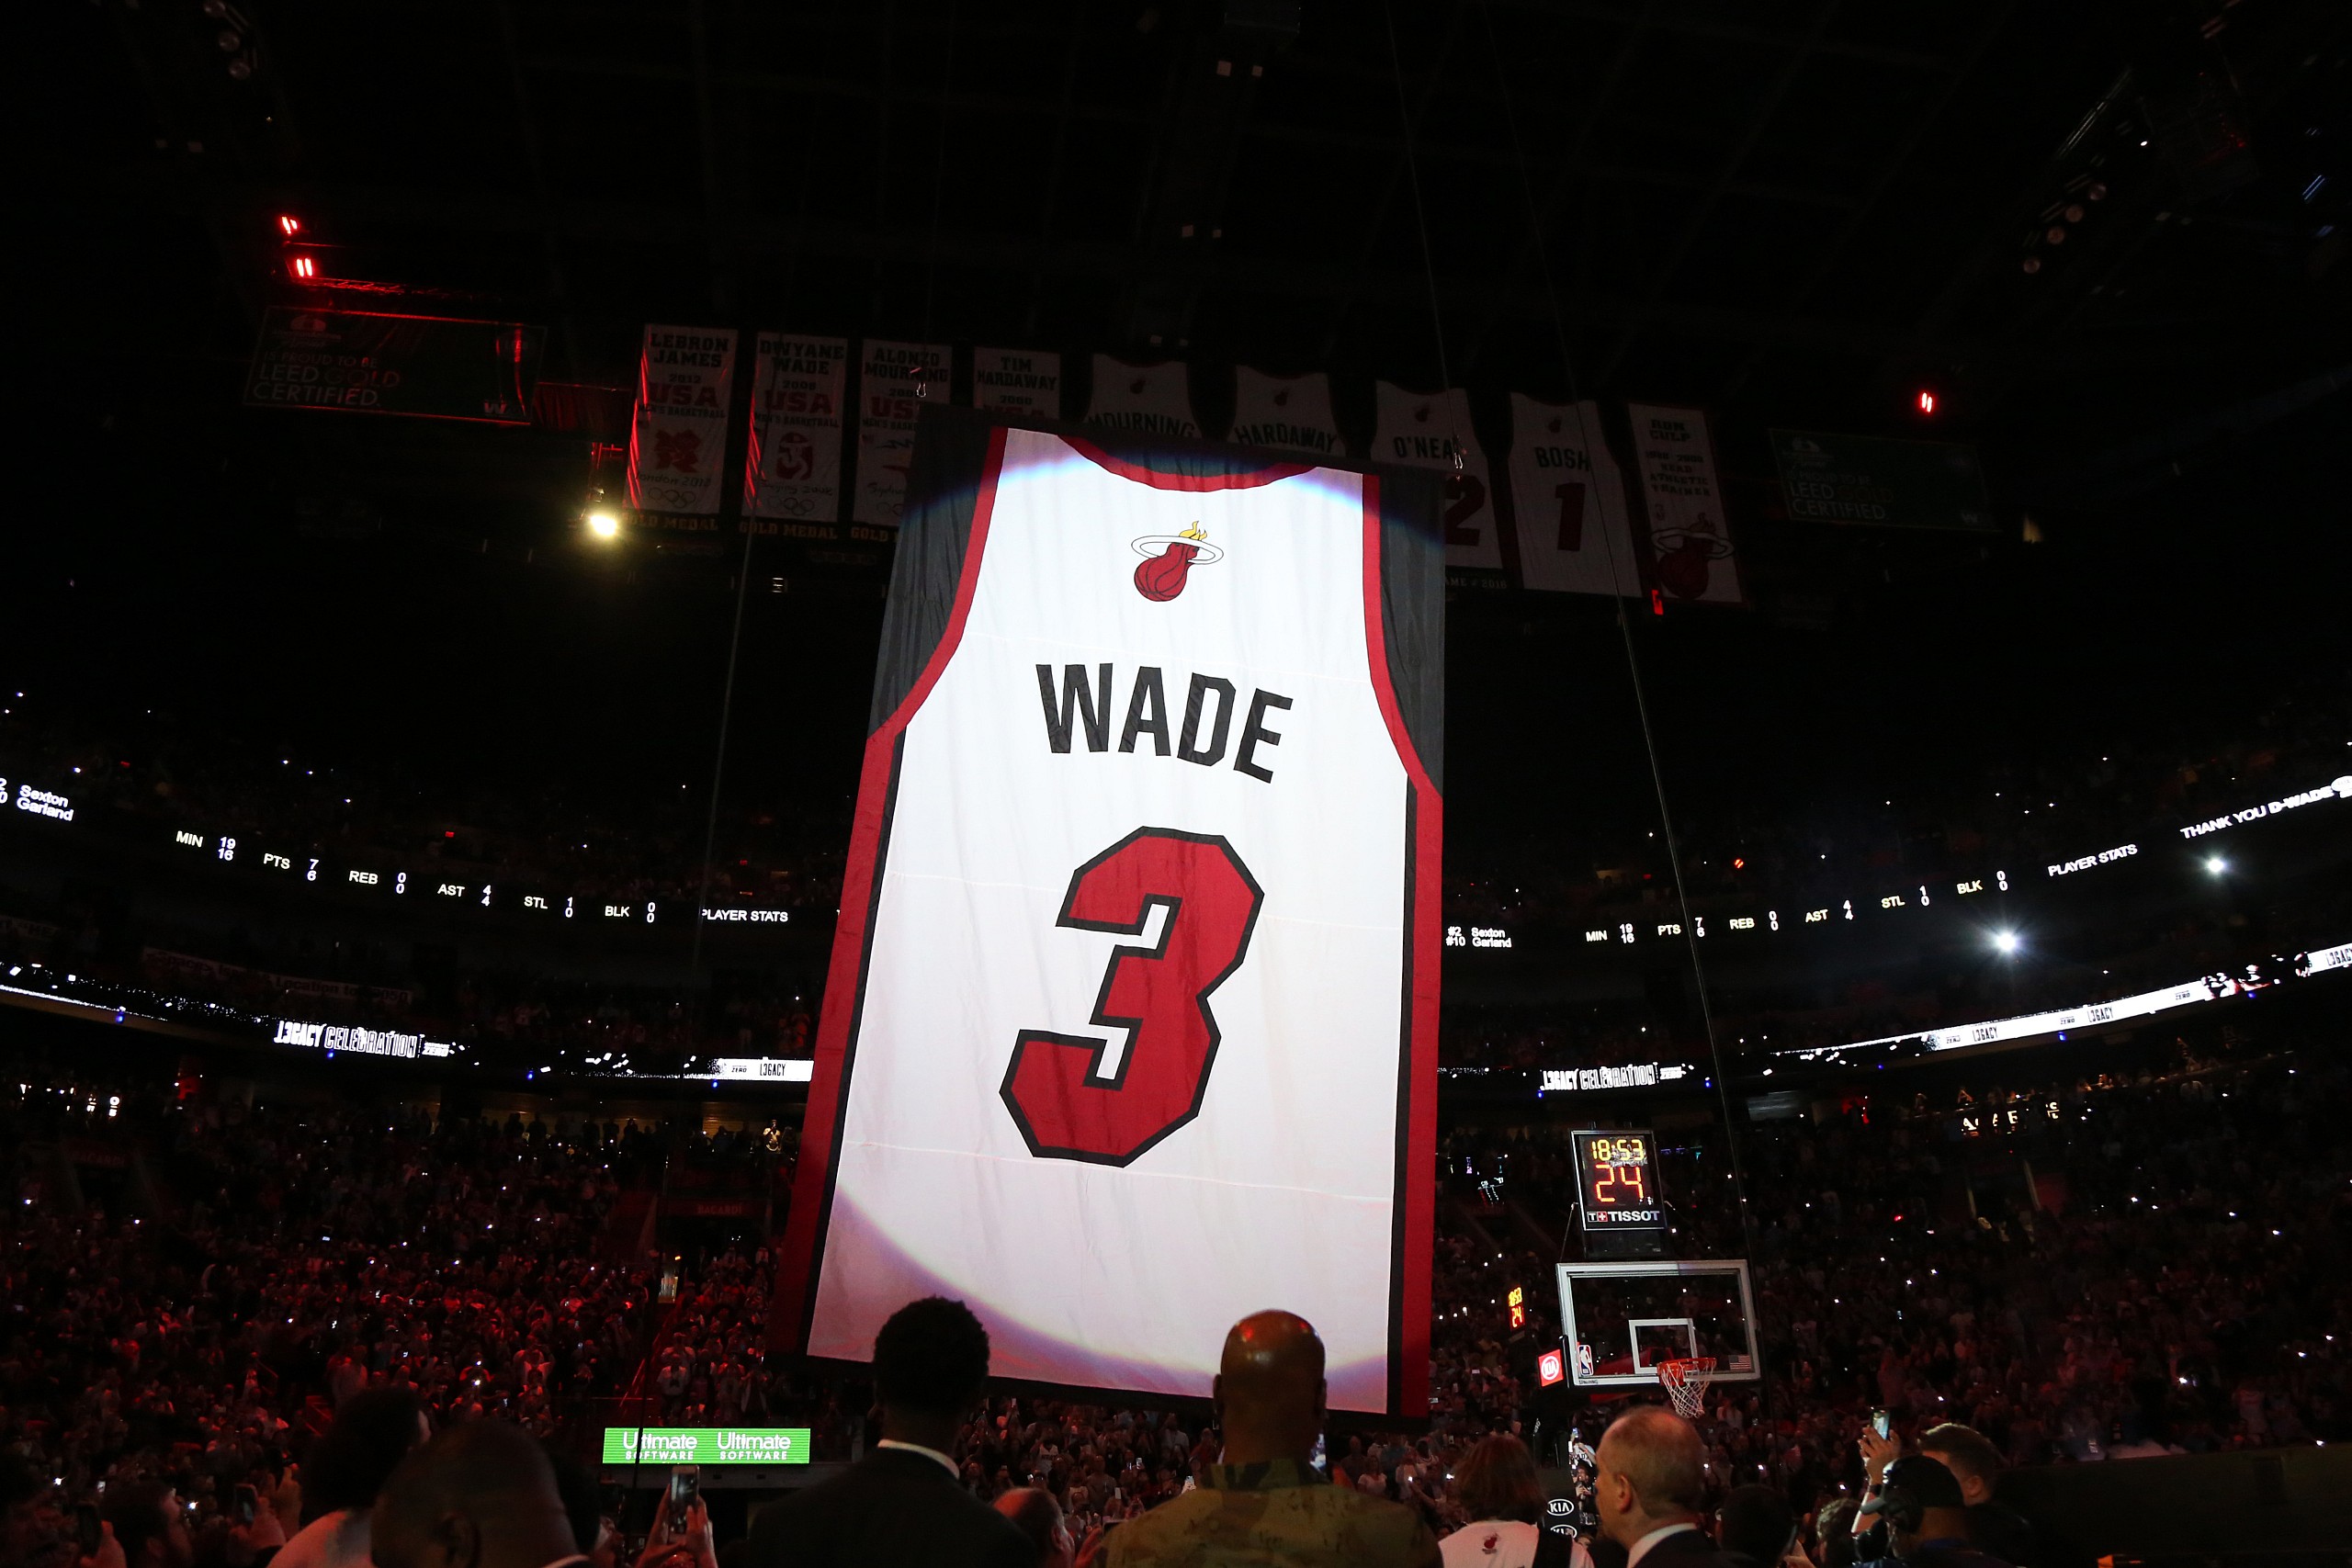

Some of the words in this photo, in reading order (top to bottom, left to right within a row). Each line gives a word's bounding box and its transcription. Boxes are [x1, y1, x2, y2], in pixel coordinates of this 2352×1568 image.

[650, 333, 729, 352] LEBRON
[760, 340, 845, 360] DWYANE
[653, 349, 722, 367] JAMES
[771, 356, 830, 376] WADE
[874, 346, 941, 367] ALONZO
[1001, 356, 1033, 372] TIM
[258, 363, 320, 383] LEED
[864, 362, 948, 383] MOURNG
[977, 369, 1057, 390] HARDAWAY
[649, 381, 720, 409] USA
[764, 389, 833, 414] USA
[1235, 423, 1337, 453] HARDAWAY
[1393, 435, 1462, 462] O'NEA
[1535, 446, 1590, 472] BOSH
[1790, 480, 1835, 499] LEED
[1555, 482, 1587, 552] 1
[1035, 661, 1295, 784] WADE
[19, 784, 69, 808] Sexton
[17, 796, 74, 822] Garland
[2179, 815, 2233, 840] THANK
[2232, 805, 2267, 824] YOU
[2267, 785, 2335, 815] D-WADE
[175, 830, 204, 848] MIN
[220, 836, 236, 850] 19
[218, 848, 234, 862] 16
[263, 852, 291, 870] PTS
[309, 858, 320, 871] 7
[2048, 855, 2098, 877] PLAYER
[2098, 843, 2139, 865] STATS
[306, 869, 317, 882] 6
[348, 870, 379, 886] REB
[397, 872, 407, 884] 0
[1956, 879, 1984, 895] BLK
[1996, 870, 2006, 882] 0
[1998, 880, 2008, 891] 0
[395, 883, 405, 895] 0
[436, 883, 466, 897] AST
[482, 884, 492, 896] 4
[1881, 895, 1905, 908] STL
[1918, 885, 1927, 897] 1
[481, 895, 491, 907] 4
[523, 896, 548, 909] STL
[566, 897, 573, 908] 1
[604, 905, 630, 918] BLK
[647, 901, 656, 913] 0
[1804, 908, 1829, 923] AST
[1843, 899, 1852, 910] 4
[1920, 895, 1929, 907] 0
[564, 907, 573, 918] 0
[646, 912, 655, 924] 0
[750, 910, 789, 923] STATS
[1729, 917, 1756, 930] REB
[1769, 910, 1777, 921] 0
[1844, 909, 1854, 920] 4
[1471, 927, 1506, 939] Sexton
[1657, 924, 1682, 936] PTS
[1694, 916, 1703, 928] 7
[1770, 920, 1779, 931] 0
[1445, 936, 1466, 947] #10
[1472, 937, 1512, 949] Garland
[1585, 930, 1608, 942] MIN
[999, 825, 1266, 1169] 3
[324, 1026, 418, 1058] CELEBRATION
[1578, 1063, 1657, 1090] CELEBRATION
[1591, 1139, 1645, 1161] 18:53
[1595, 1163, 1645, 1202] 24
[1607, 1210, 1660, 1222] TISSOT
[1510, 1305, 1523, 1328] 24
[622, 1430, 698, 1450] Utimate
[717, 1430, 792, 1450] Ultimate
[719, 1450, 788, 1461] SOFTWARE
[1550, 1502, 1570, 1513] KIA
